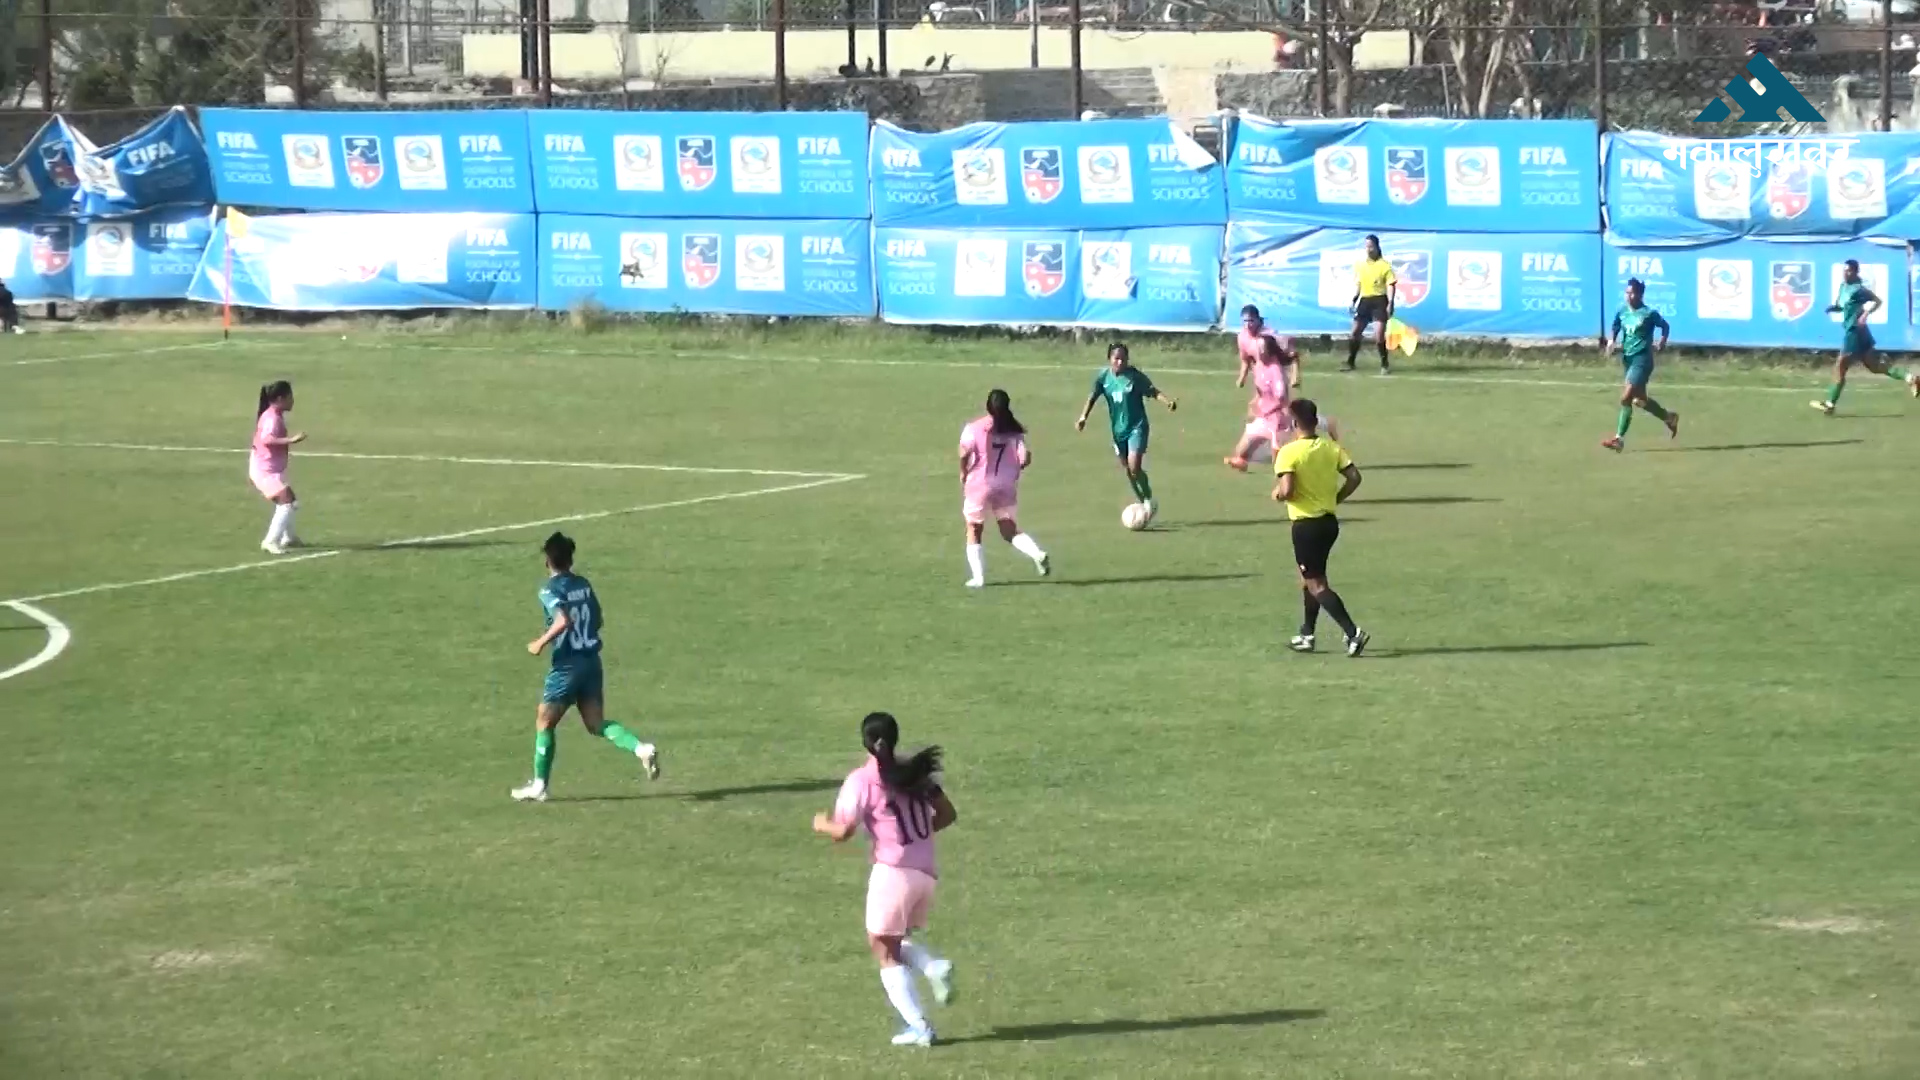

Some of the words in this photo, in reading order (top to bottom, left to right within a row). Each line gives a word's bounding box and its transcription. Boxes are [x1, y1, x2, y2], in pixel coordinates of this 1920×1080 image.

[216, 131, 258, 149] FIFA
[459, 135, 502, 153] FIFA
[544, 134, 585, 152] FIFA
[797, 137, 841, 155] FIFA
[127, 141, 176, 167] FIFA
[1239, 142, 1282, 164] FIFA
[1519, 147, 1567, 165] FIFA
[1620, 158, 1664, 180] FIFA
[799, 181, 854, 193] SCHOOLS
[887, 191, 938, 204] SCHOOLS
[149, 223, 188, 239] FIFA
[466, 229, 508, 246] FIFA
[551, 232, 591, 250] FIFA
[801, 237, 845, 255] FIFA
[887, 240, 926, 257] FIFA
[1149, 244, 1191, 265] FIFA
[1522, 252, 1569, 271] FIFA
[1618, 256, 1664, 276] FIFA
[466, 271, 521, 282] SCHOOLS
[803, 280, 858, 292] SCHOOLS
[1522, 298, 1581, 311] SCHOOLS
[992, 443, 1006, 466] 7
[888, 797, 929, 846] 10
